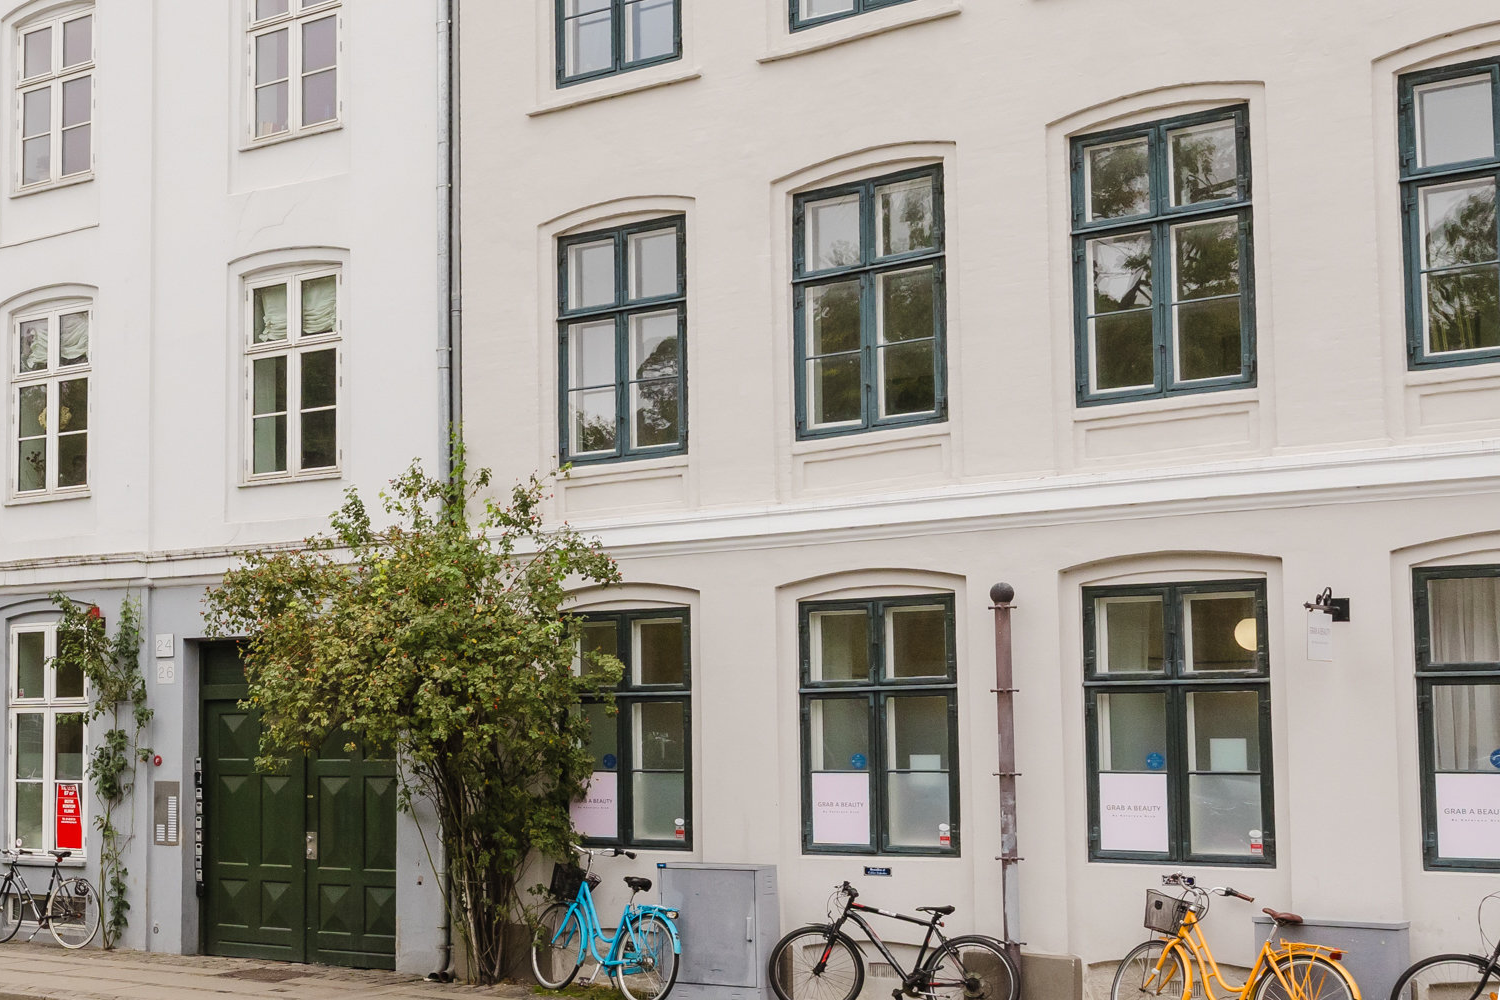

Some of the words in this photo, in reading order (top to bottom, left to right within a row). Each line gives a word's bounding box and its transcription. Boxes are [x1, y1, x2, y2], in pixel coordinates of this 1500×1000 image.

[156, 639, 172, 652] 24
[158, 666, 174, 679] 26
[1443, 807, 1467, 815] GRAB
